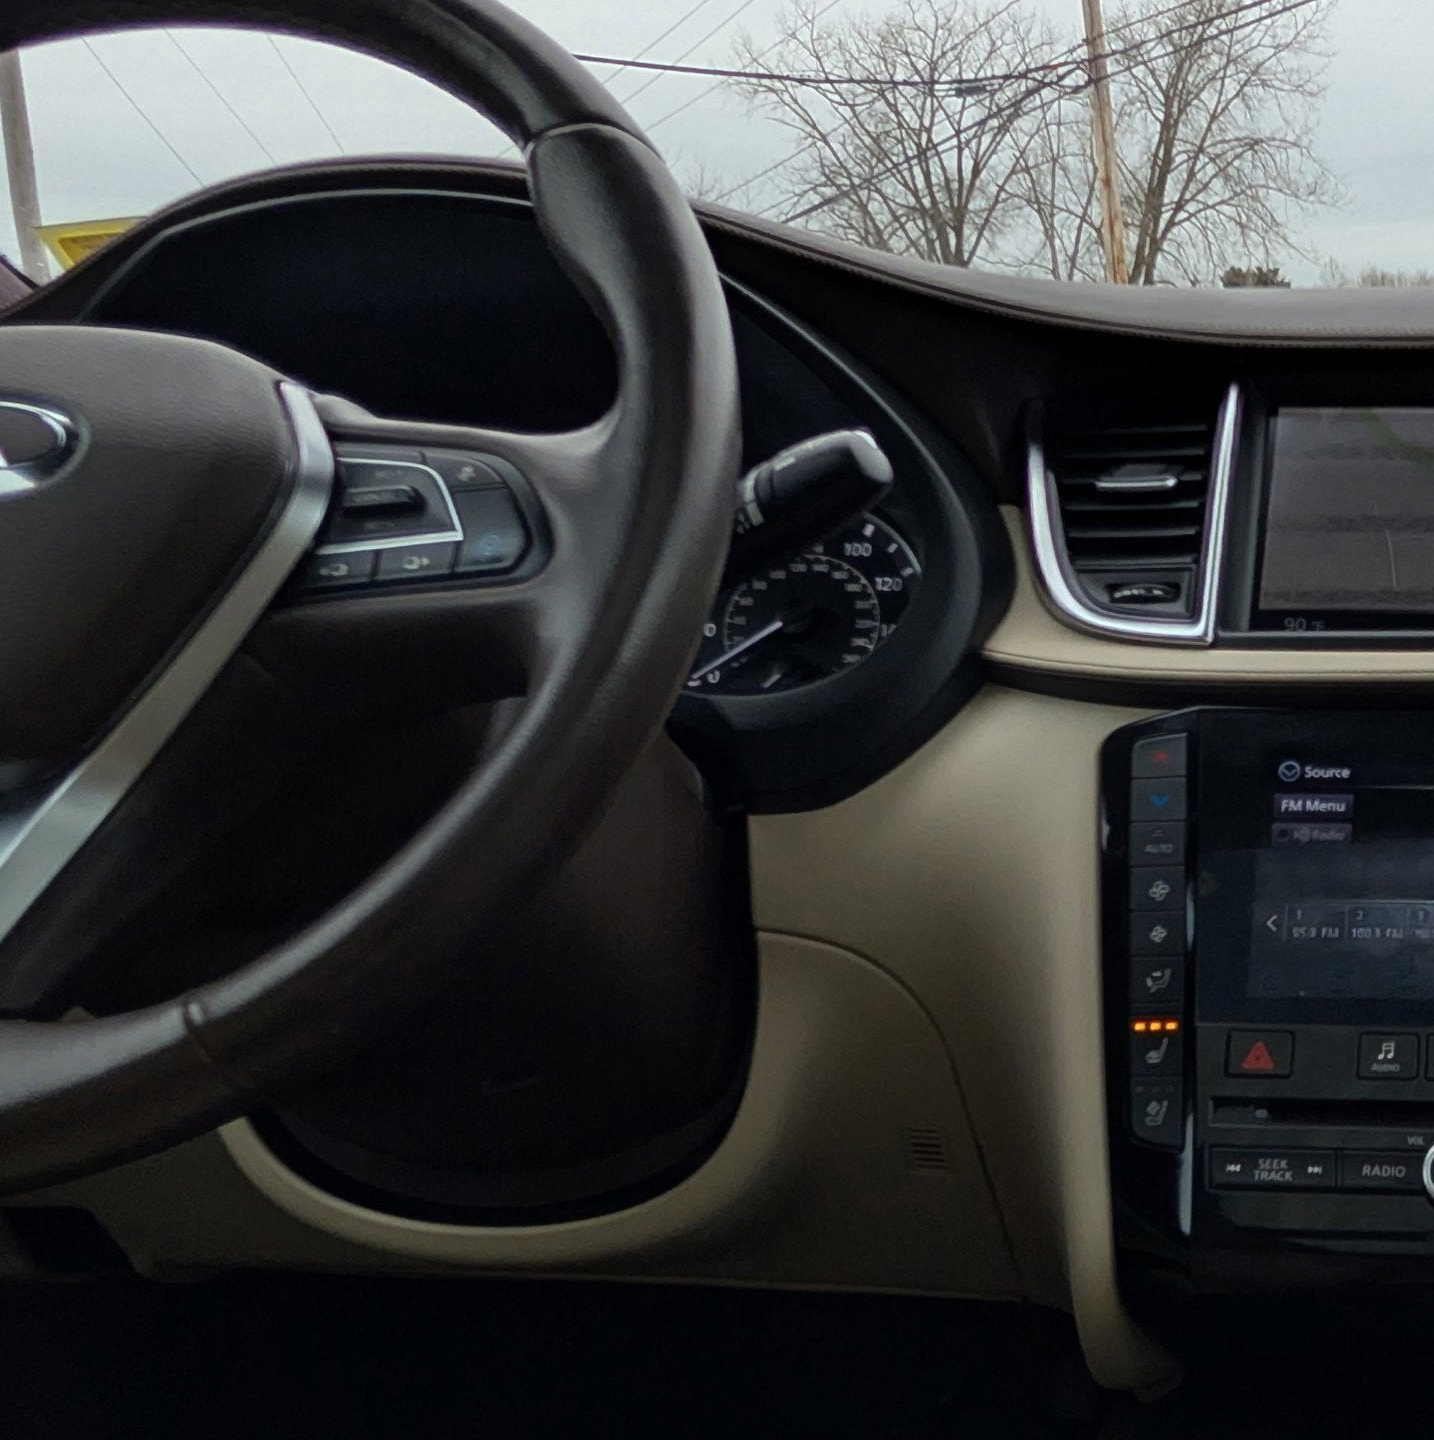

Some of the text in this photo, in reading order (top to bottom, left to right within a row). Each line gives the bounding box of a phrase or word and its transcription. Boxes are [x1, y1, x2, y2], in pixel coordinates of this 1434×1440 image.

[844, 542, 872, 557] 100
[875, 577, 903, 591] 120
[1304, 765, 1351, 779] Source
[1280, 799, 1346, 812] FM Menu
[1355, 910, 1364, 920] 2
[1321, 927, 1340, 939] FM
[1386, 928, 1404, 939] FM
[1370, 1063, 1401, 1073] AUDIO
[1406, 1136, 1425, 1146] VOL
[1257, 1158, 1289, 1170] SEEK
[1253, 1170, 1293, 1182] TRACK
[1361, 1164, 1406, 1178] RADIO
